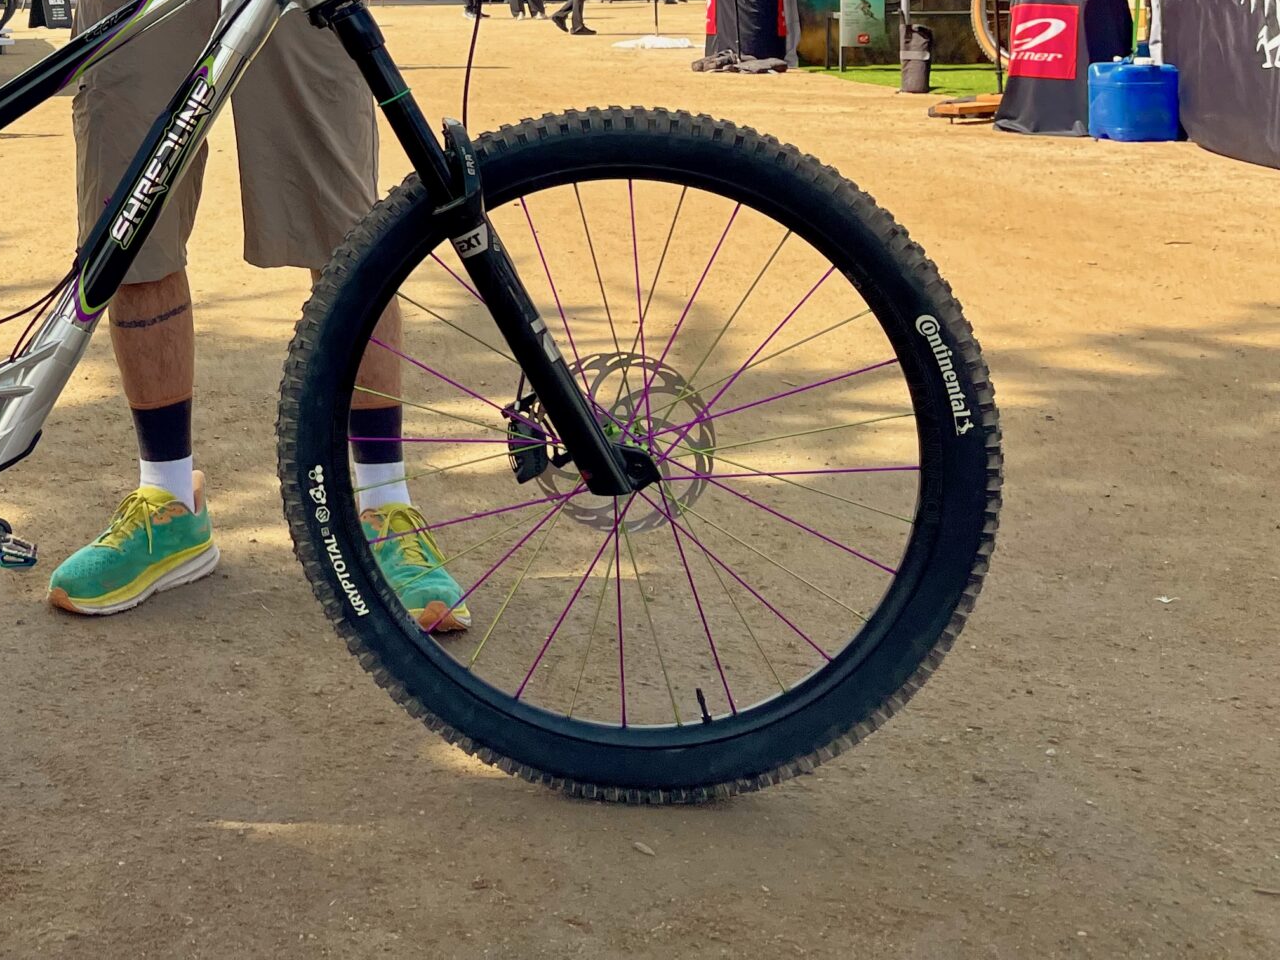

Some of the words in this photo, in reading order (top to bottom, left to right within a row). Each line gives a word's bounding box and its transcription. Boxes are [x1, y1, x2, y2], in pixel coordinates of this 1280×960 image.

[456, 233, 481, 253] EXT
[915, 314, 972, 418] Continental
[326, 534, 370, 618] KRYPTOTAL
